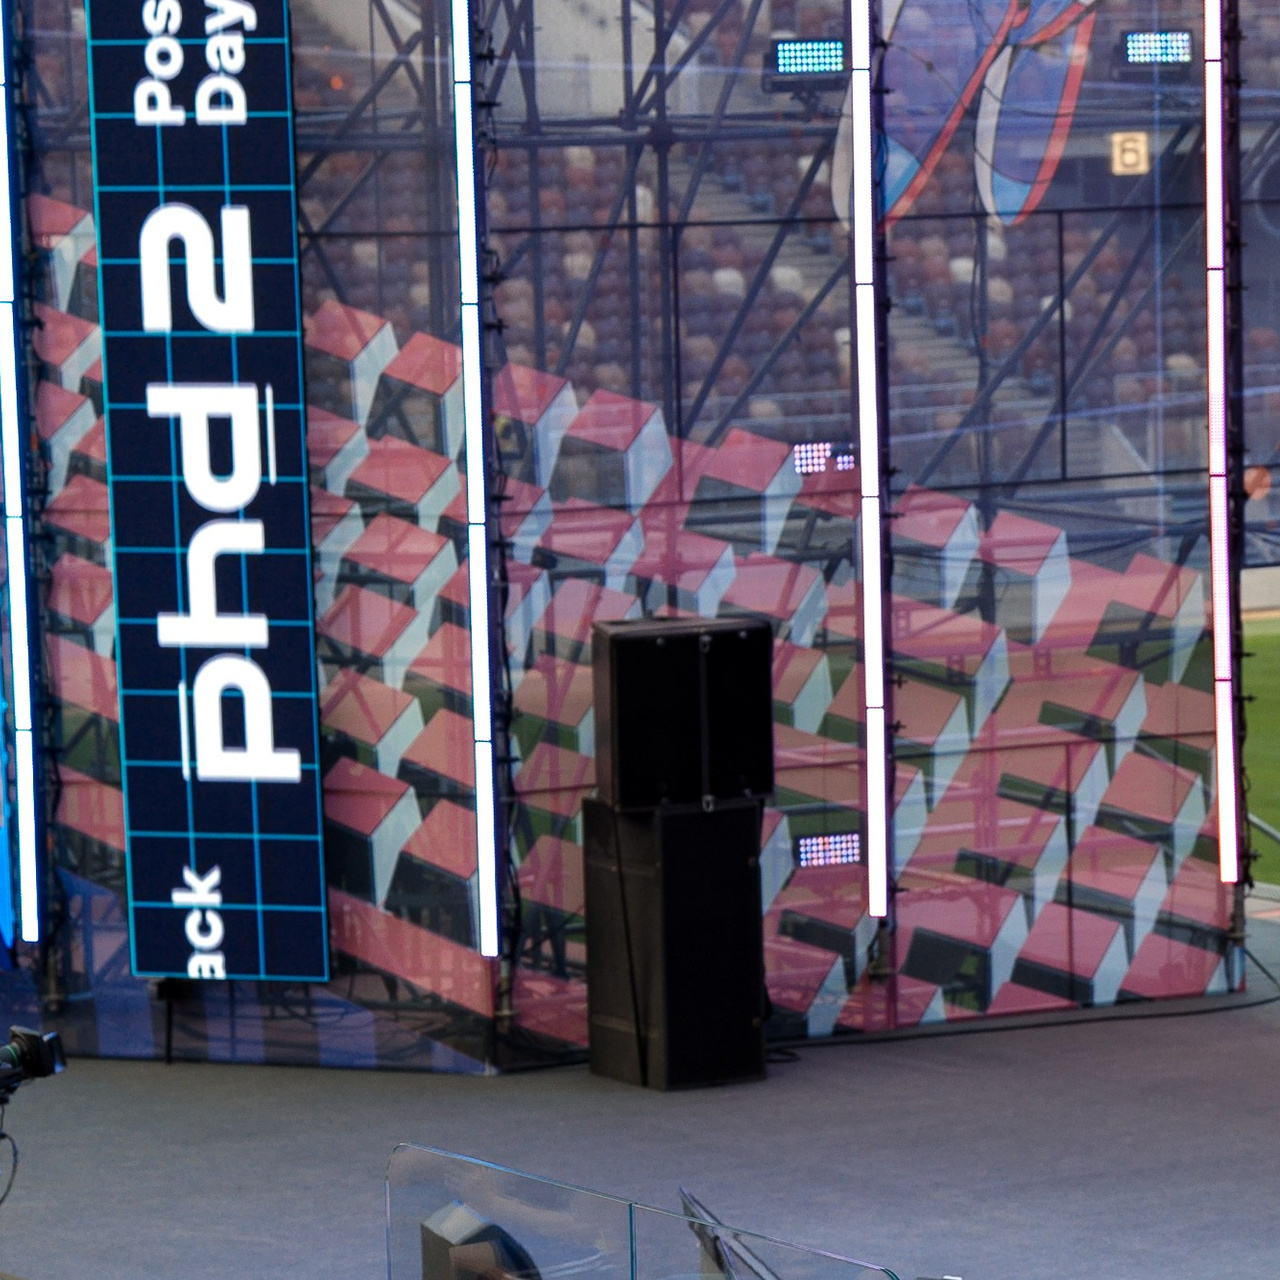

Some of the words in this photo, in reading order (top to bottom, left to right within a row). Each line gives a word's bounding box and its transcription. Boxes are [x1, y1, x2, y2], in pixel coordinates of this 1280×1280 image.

[134, 0, 186, 126] Pos
[195, 0, 257, 125] Day
[1119, 137, 1142, 169] 6
[140, 203, 255, 334] 2
